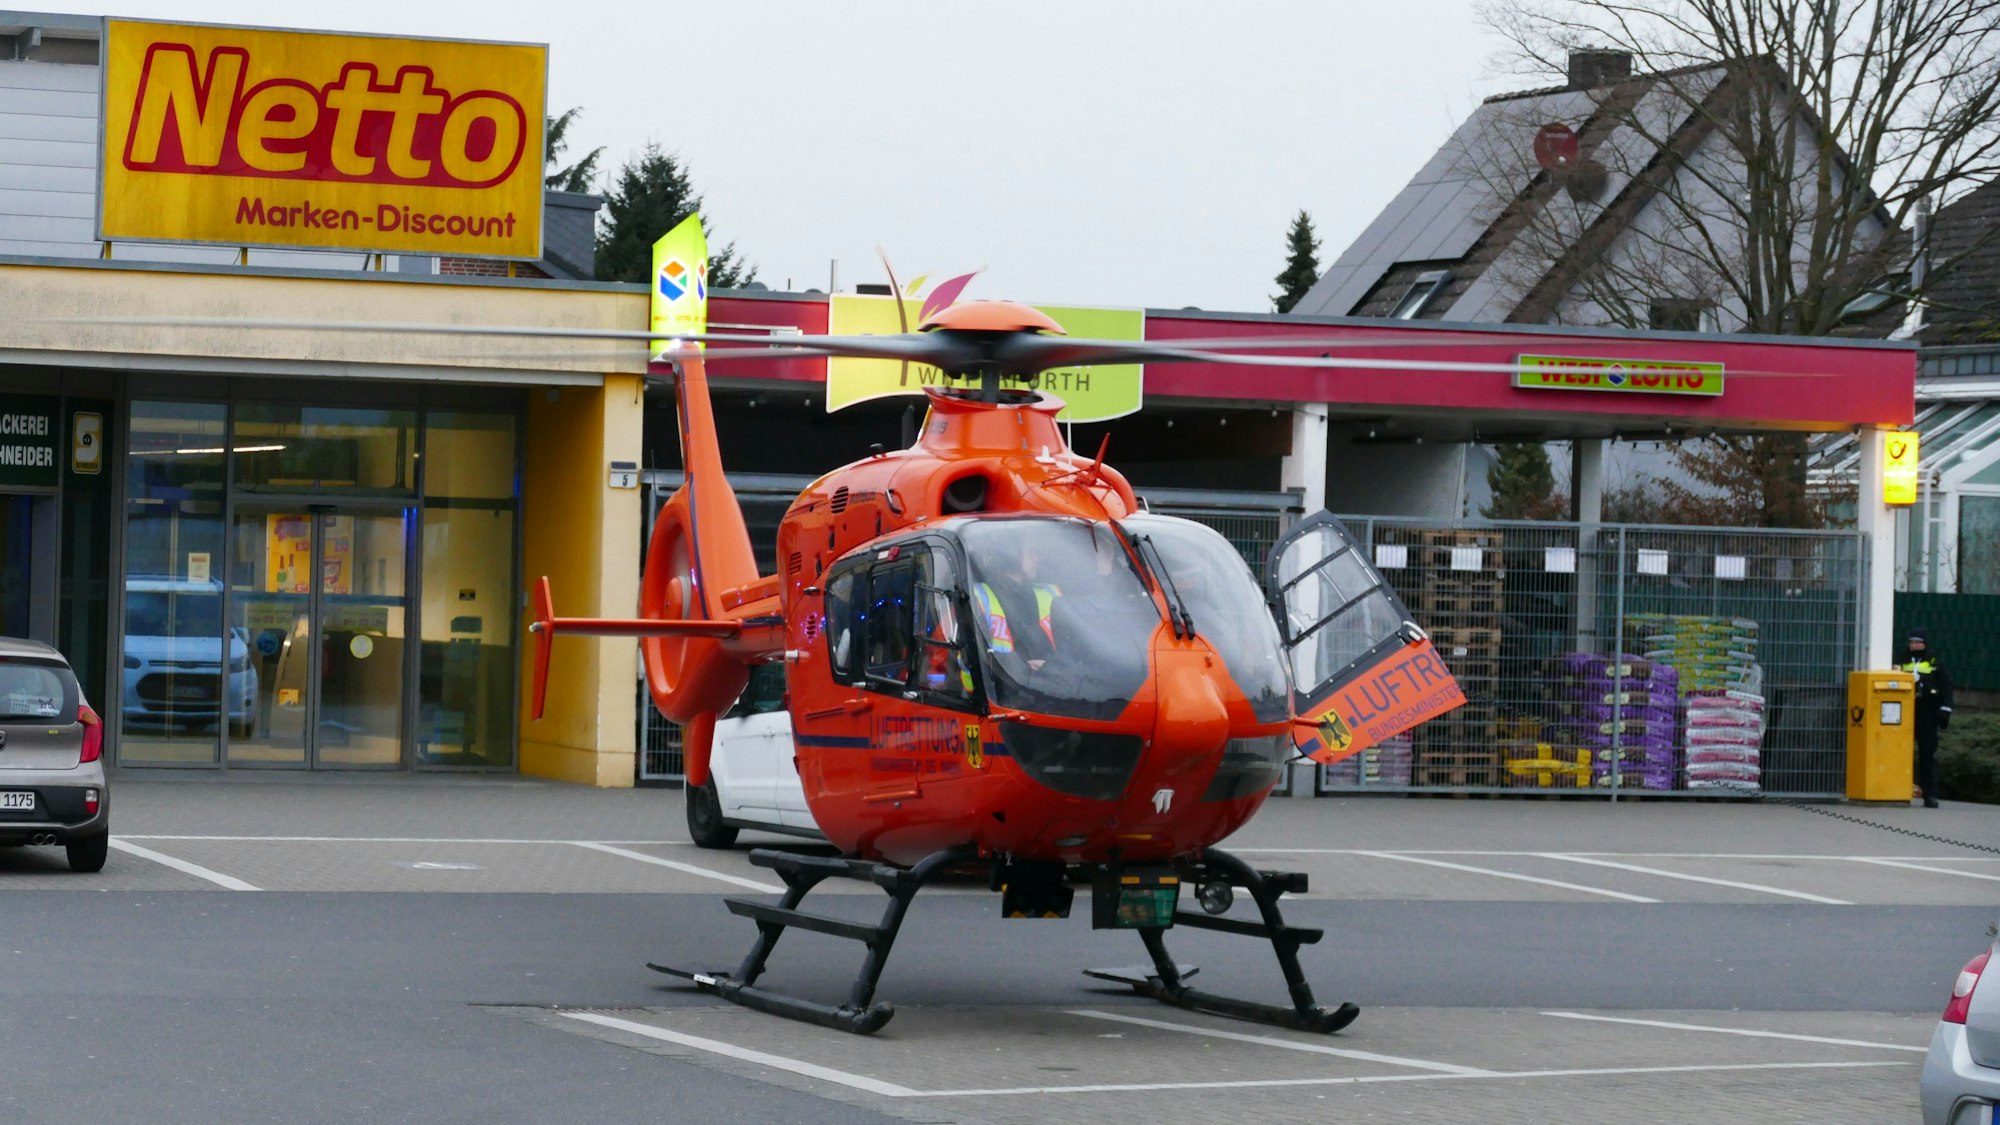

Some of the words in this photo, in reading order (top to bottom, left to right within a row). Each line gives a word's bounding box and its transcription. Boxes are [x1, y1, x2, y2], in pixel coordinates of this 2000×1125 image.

[124, 43, 526, 188] Netto
[235, 197, 517, 238] Marken-Discount
[1538, 360, 1603, 384] WEST
[1630, 364, 1705, 389] LOTTO
[0, 413, 48, 436] CKEREI
[622, 474, 629, 487] 5
[4, 792, 33, 807] 1175
